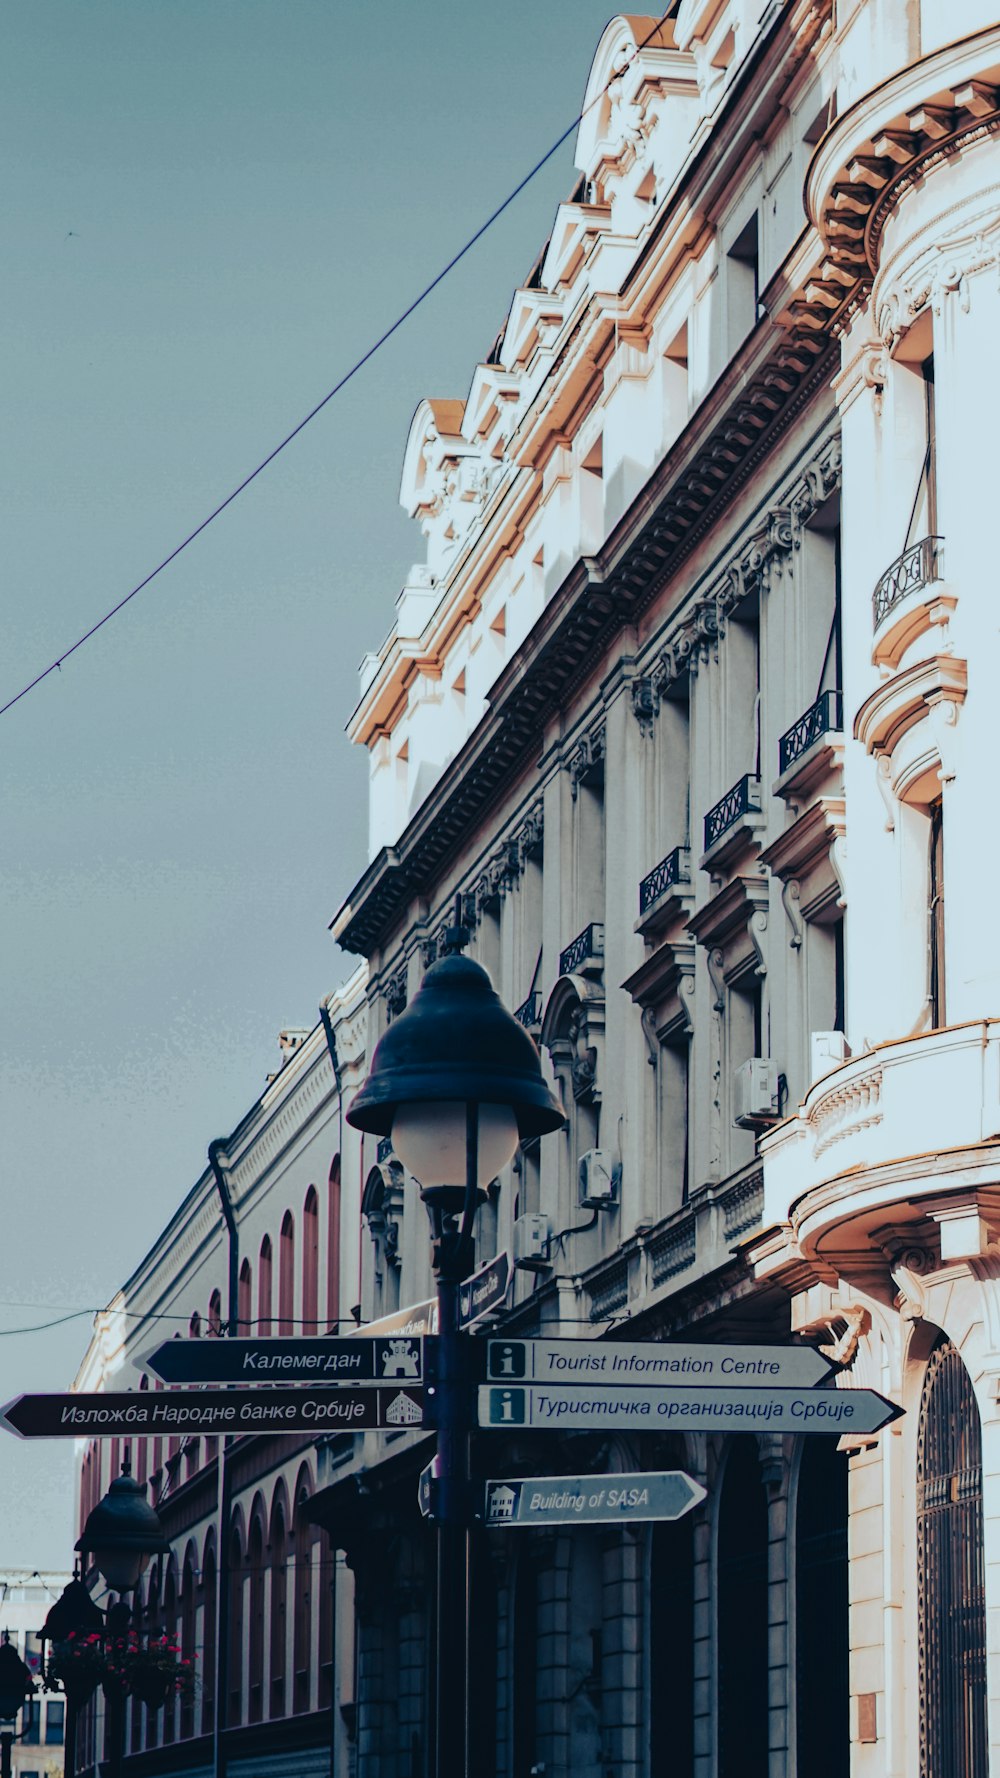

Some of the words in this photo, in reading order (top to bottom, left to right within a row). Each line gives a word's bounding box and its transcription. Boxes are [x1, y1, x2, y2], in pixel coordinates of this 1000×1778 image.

[243, 1352, 361, 1371] Калемегдан
[548, 1353, 606, 1370] Tourist
[612, 1354, 713, 1373] Information
[720, 1357, 780, 1375] Centre
[61, 1406, 148, 1423] Изложба
[152, 1405, 236, 1424] Народне
[240, 1403, 297, 1420] банке
[301, 1400, 366, 1420] Србије
[538, 1396, 651, 1417] Туристичка
[657, 1400, 784, 1420] организација
[790, 1400, 855, 1421] Србије
[529, 1492, 585, 1512] Building
[588, 1491, 605, 1507] of
[606, 1488, 649, 1507] SASA
